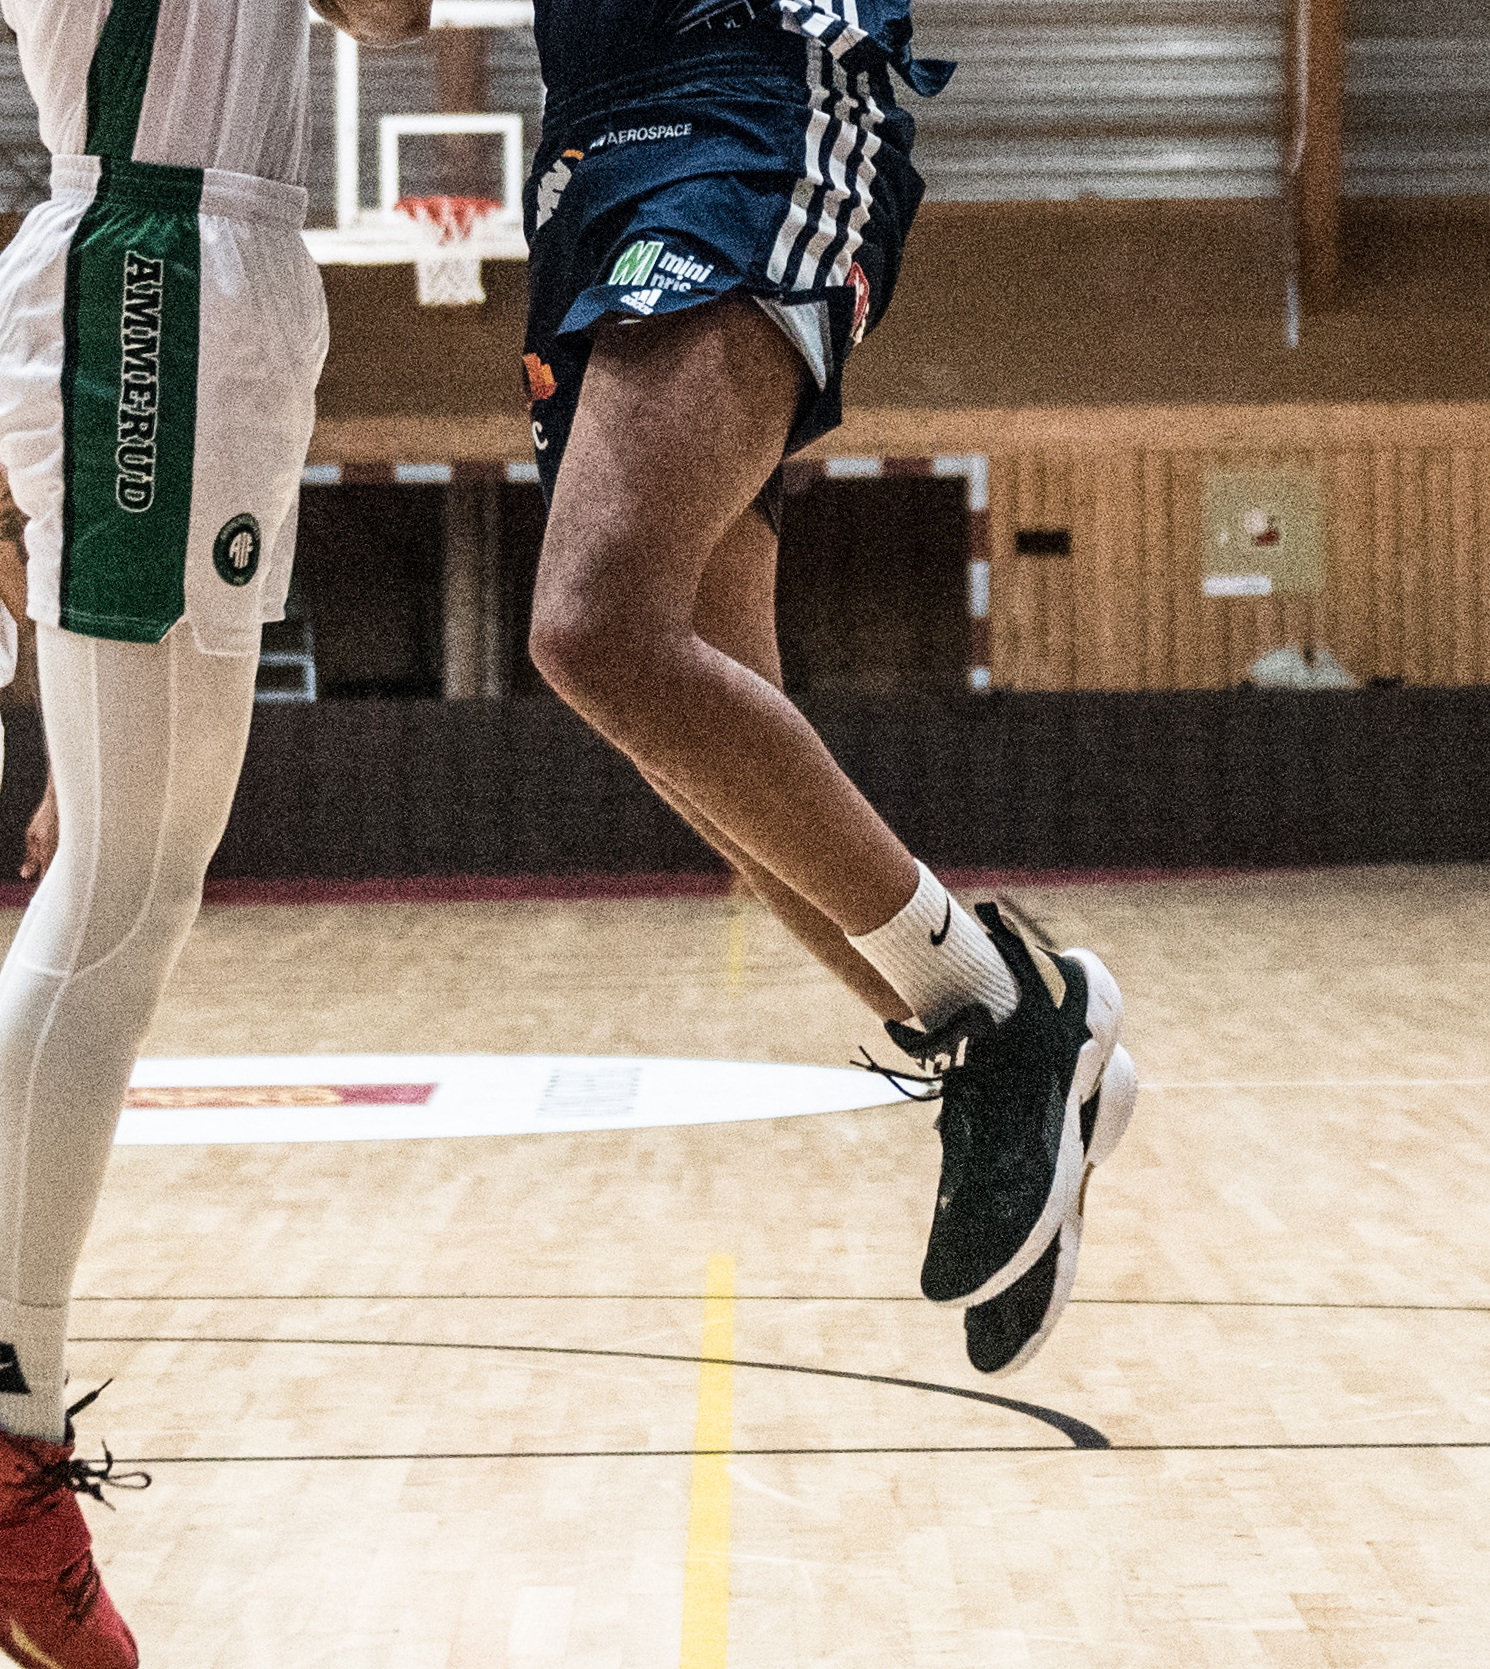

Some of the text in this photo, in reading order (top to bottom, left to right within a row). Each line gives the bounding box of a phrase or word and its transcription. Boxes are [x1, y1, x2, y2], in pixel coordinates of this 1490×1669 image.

[607, 123, 692, 145] AEROSPACE
[657, 251, 714, 283] mini
[115, 250, 163, 513] AMMERUD
